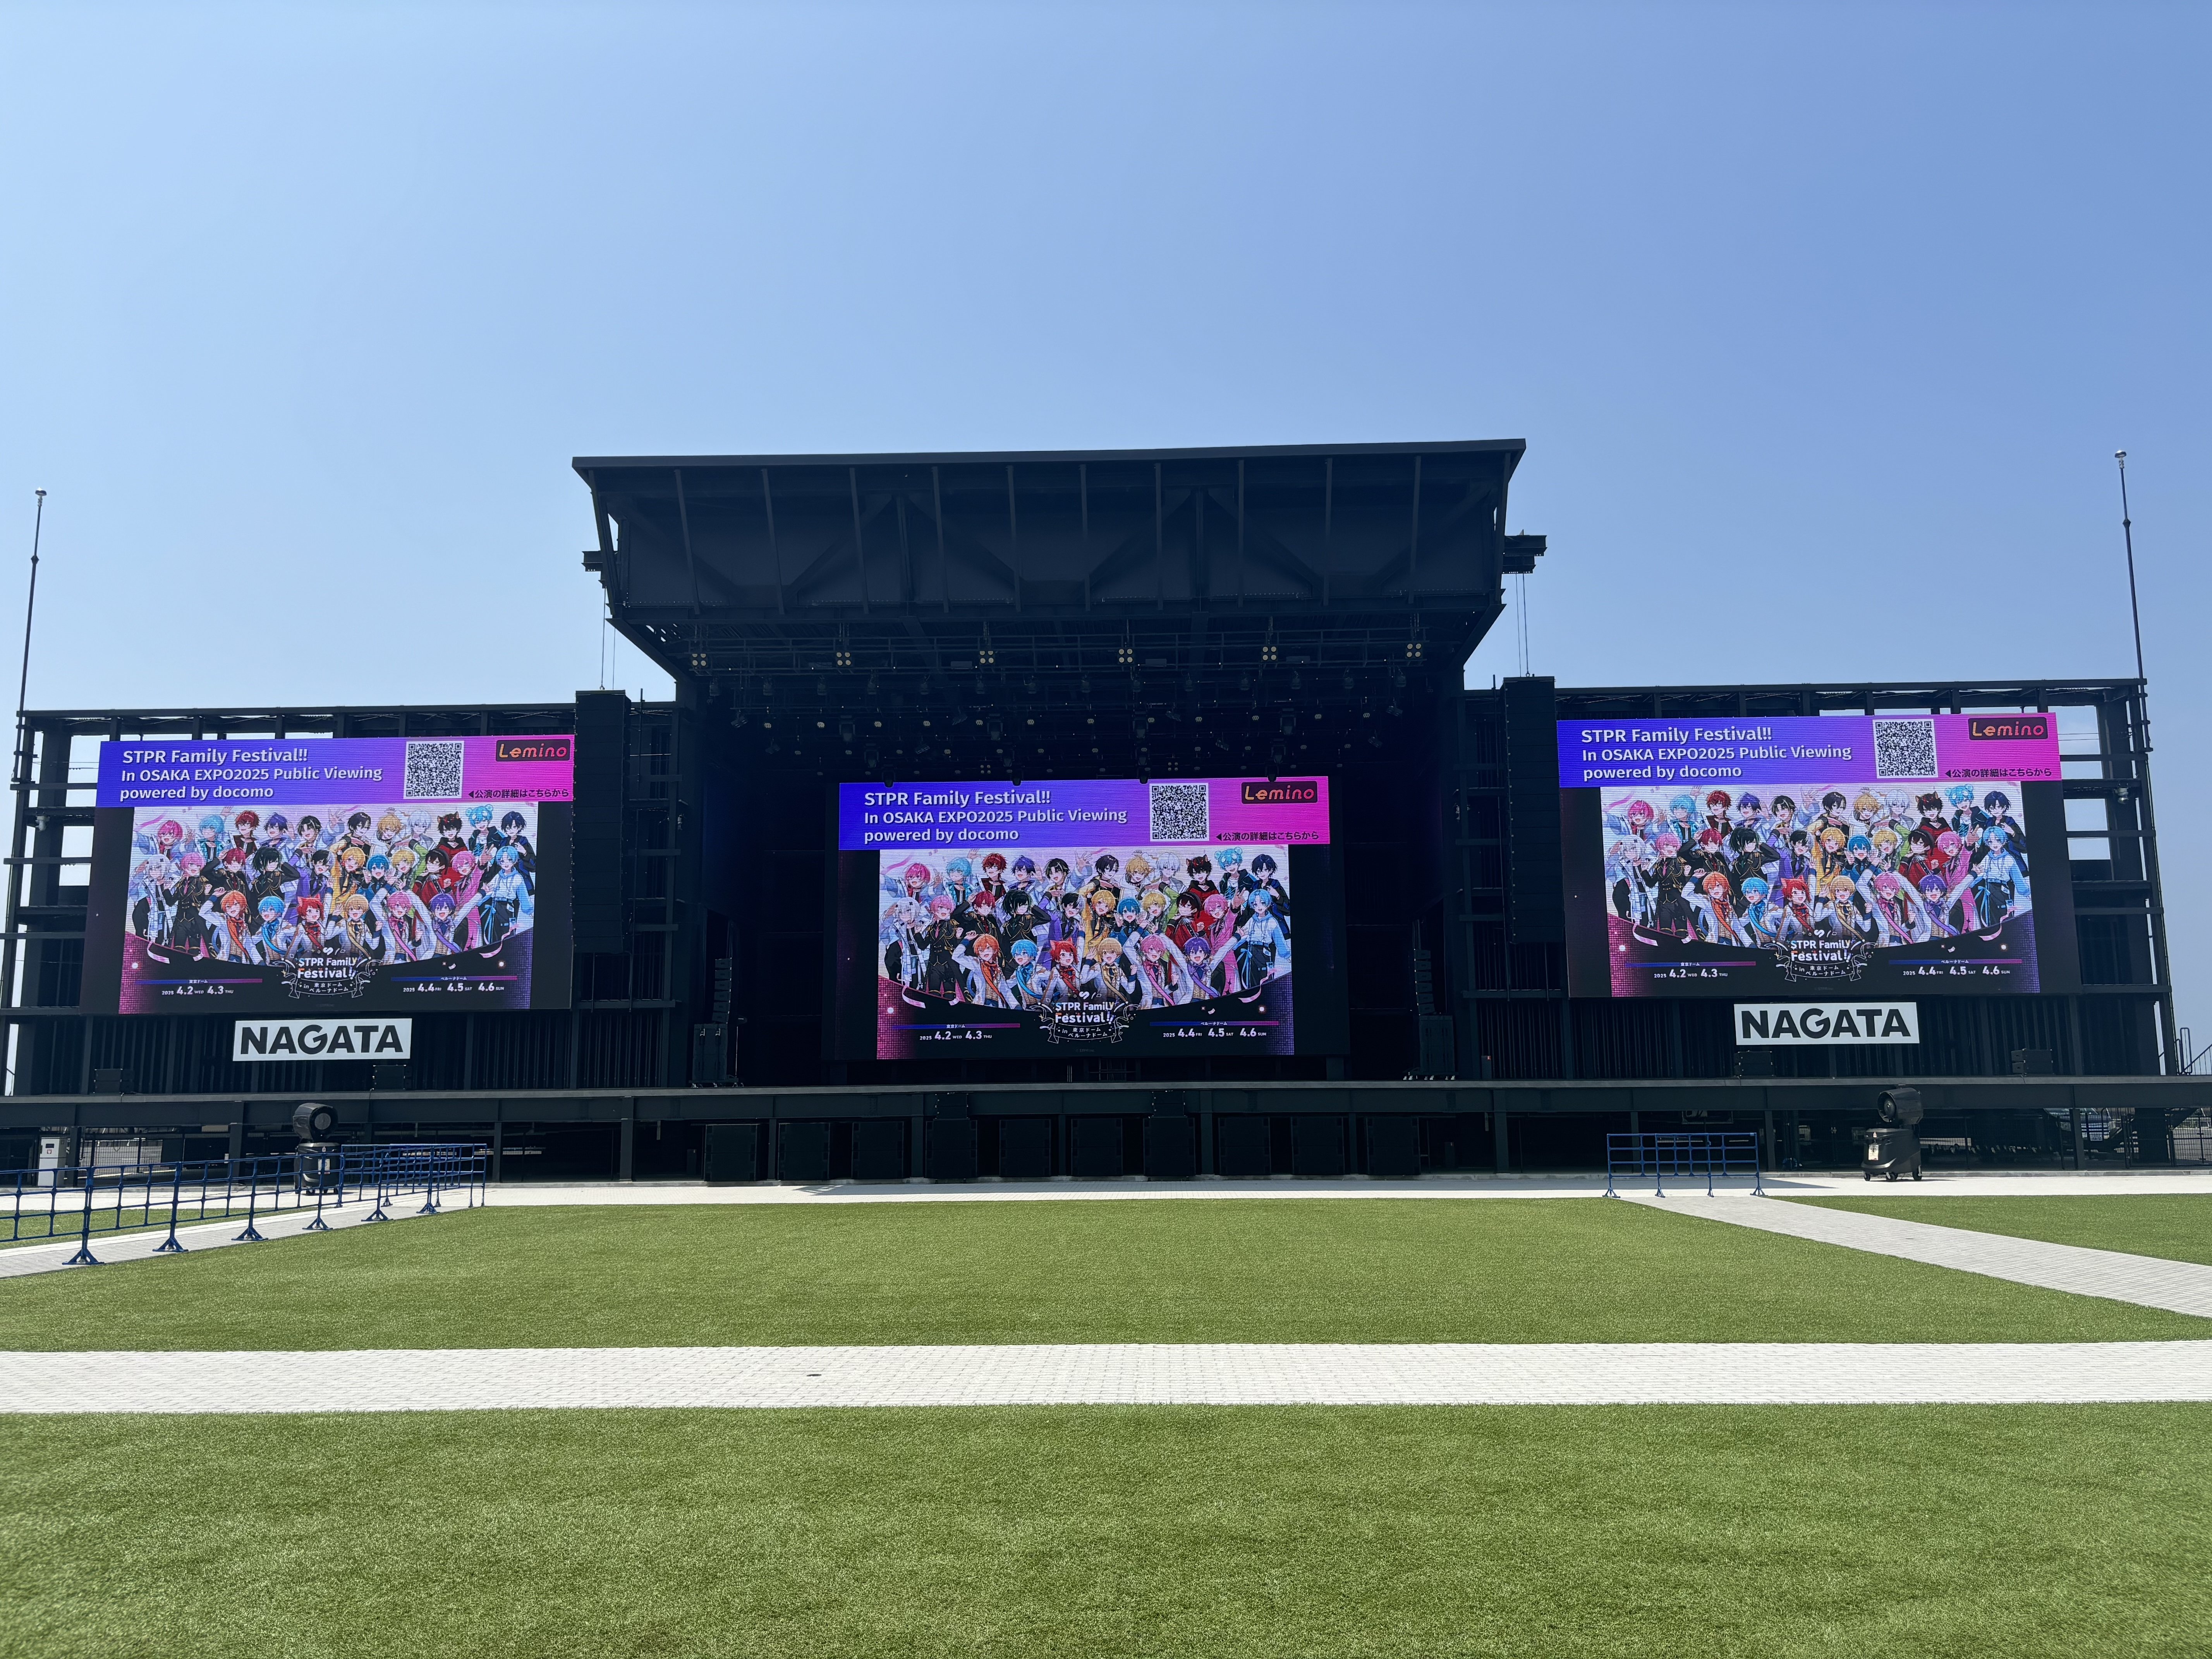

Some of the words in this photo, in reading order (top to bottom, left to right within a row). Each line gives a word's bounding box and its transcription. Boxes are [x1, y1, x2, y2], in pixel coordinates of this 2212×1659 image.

[1582, 729, 1626, 743] STPR
[1632, 727, 1689, 744] Family
[1695, 725, 1772, 741] Festival!!
[1972, 721, 2044, 736] Lemino
[123, 750, 166, 763] STPR
[171, 748, 227, 765] Family
[232, 747, 307, 762] Festival!!
[499, 744, 567, 758] Lemino
[1583, 750, 1597, 761] In
[1602, 749, 1654, 761] OSAKA
[1658, 747, 1735, 759] EXPO2025
[1740, 745, 1787, 759] Public
[1791, 745, 1852, 760] Viewing
[122, 771, 135, 781] In
[140, 770, 190, 781] OSAKA
[195, 769, 269, 781] EXPO2025
[274, 766, 320, 779] Public
[324, 766, 383, 781] Viewing
[1584, 766, 1651, 782] powered
[1657, 766, 1675, 780] by
[1680, 765, 1741, 777] docomo
[1952, 768, 2052, 778] 公演の詳細はこちらから
[120, 786, 186, 802] powered
[191, 786, 209, 800] by
[213, 785, 273, 797] docomo
[475, 789, 569, 798] 公演の詳細はこちらから
[864, 792, 908, 805] STPR
[914, 790, 970, 808] Family
[975, 789, 1050, 804] Festival!!
[1245, 785, 1314, 800] Lemino
[865, 813, 878, 824] In
[883, 812, 934, 823] OSAKA
[939, 811, 1013, 823] EXPO2025
[1018, 809, 1064, 822] Public
[1068, 808, 1127, 823] Viewing
[865, 829, 930, 845] powered
[936, 828, 953, 843] by
[958, 828, 1018, 840] docomo
[1223, 831, 1319, 841] 公演の詳細はこちらから
[1791, 940, 1816, 949] STPR
[298, 958, 324, 966] STPR
[1669, 969, 1686, 978] 4.2
[1701, 969, 1717, 977] 4.3
[1918, 967, 1936, 975] 4.4
[1949, 966, 1966, 975] 4.5
[1982, 966, 2000, 975] 4.6
[177, 986, 193, 995] 4.2
[207, 986, 224, 994] 4.3
[417, 983, 435, 992] 4.4
[447, 983, 464, 991] 4.5
[478, 982, 495, 991] 4.6
[1055, 1002, 1080, 1011] STPR
[1741, 1008, 1911, 1039] NAGATA
[240, 1024, 404, 1054] NAGATA
[934, 1031, 951, 1040] 4.2
[965, 1031, 982, 1039] 4.3
[1178, 1029, 1195, 1037] 4.4
[1208, 1028, 1224, 1037] 4.5
[1240, 1028, 1256, 1037] 4.6
